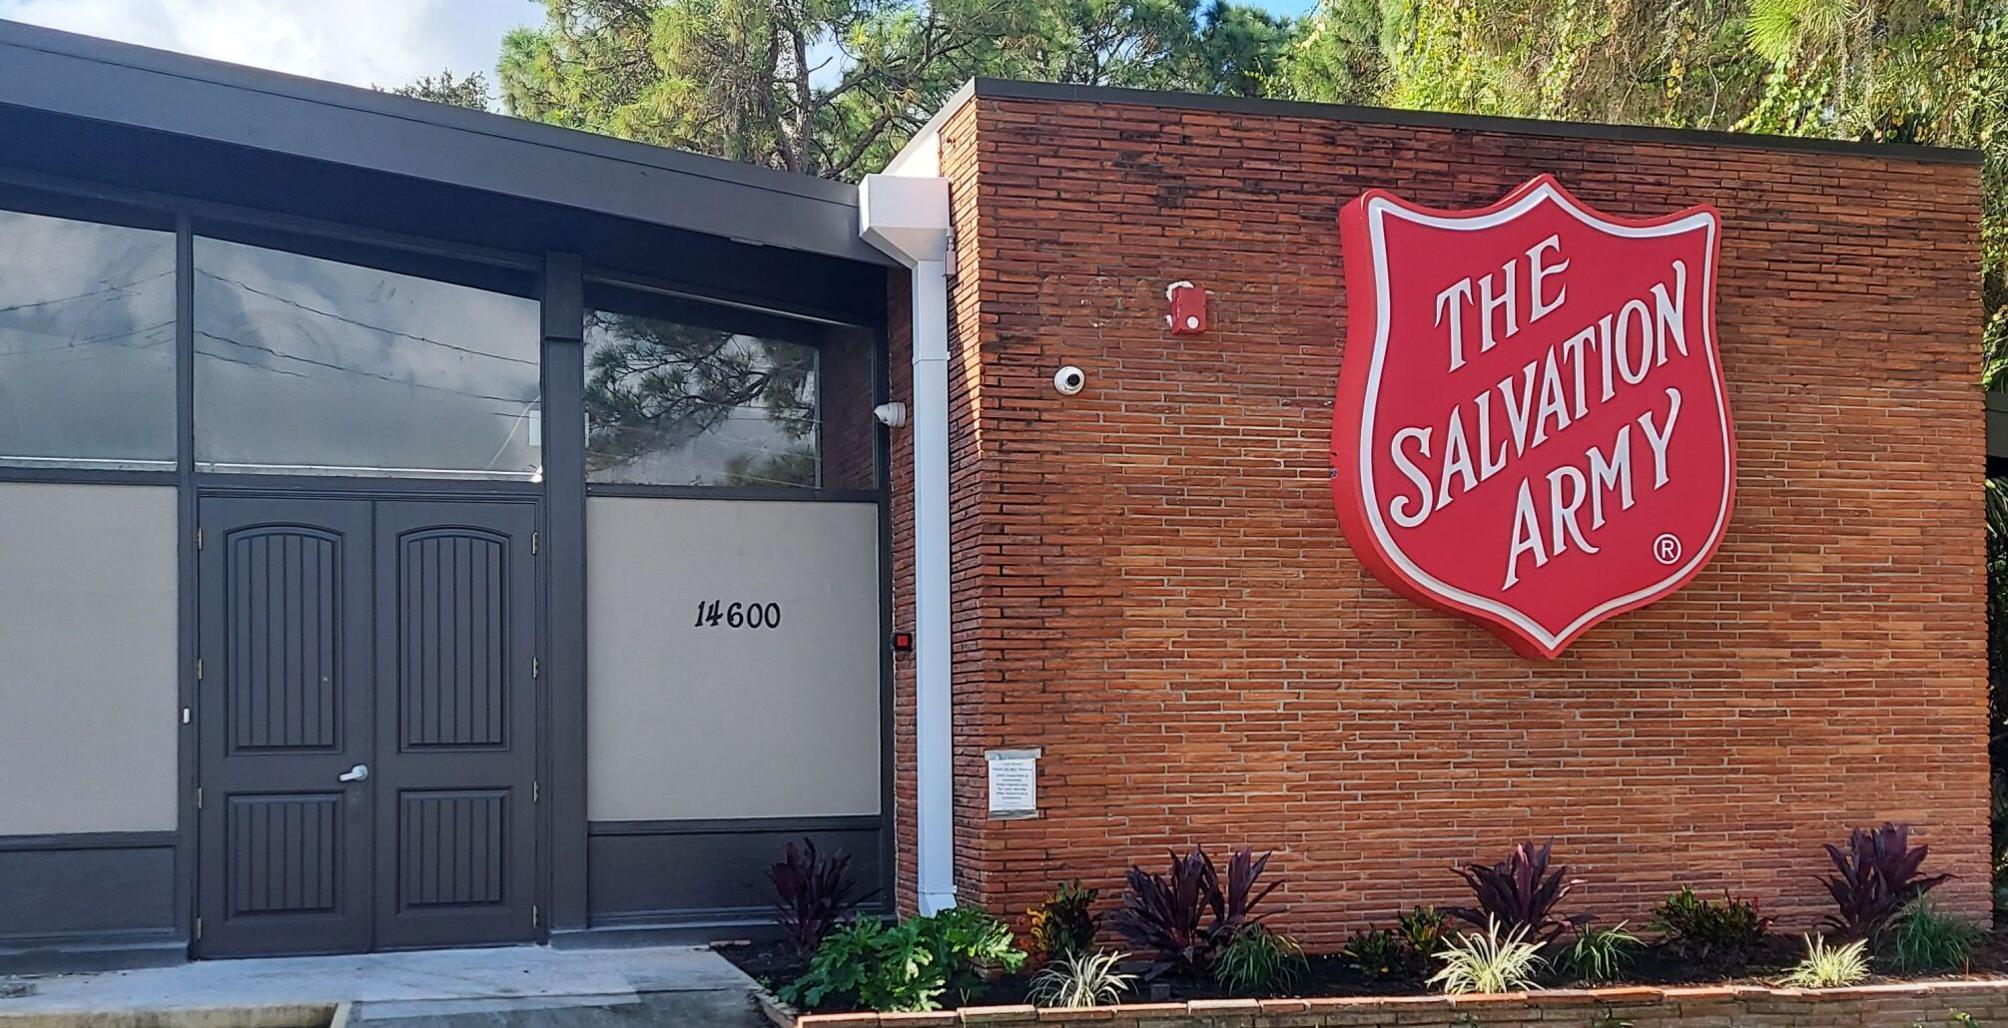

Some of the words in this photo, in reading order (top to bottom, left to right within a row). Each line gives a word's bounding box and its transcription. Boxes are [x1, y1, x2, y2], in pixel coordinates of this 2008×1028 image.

[1434, 234, 1570, 373] THE
[1390, 259, 1688, 528] SALVATION
[1501, 387, 1682, 592] ARMY
[694, 599, 781, 629] 14600
